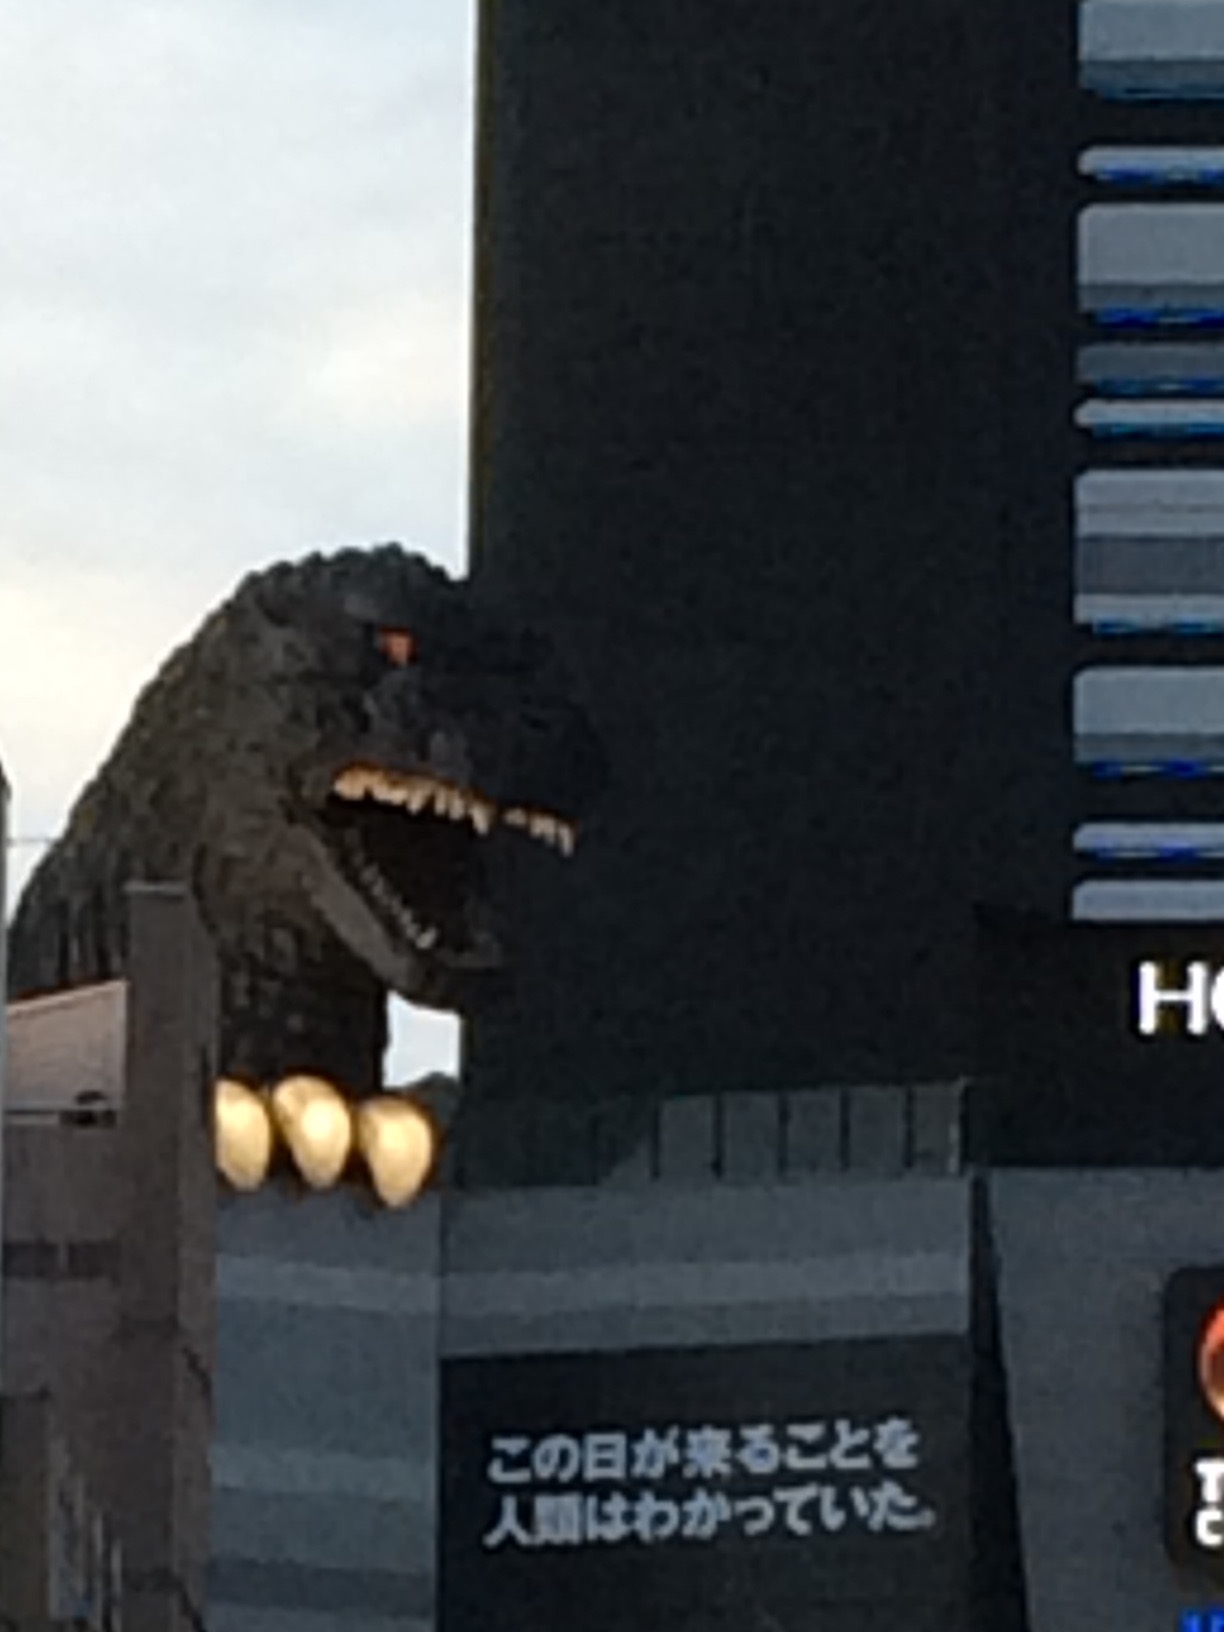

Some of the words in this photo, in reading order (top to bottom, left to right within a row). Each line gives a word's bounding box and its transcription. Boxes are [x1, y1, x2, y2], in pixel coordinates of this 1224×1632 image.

[1139, 960, 1224, 1035] H
[486, 1417, 920, 1484] この日が来ることを
